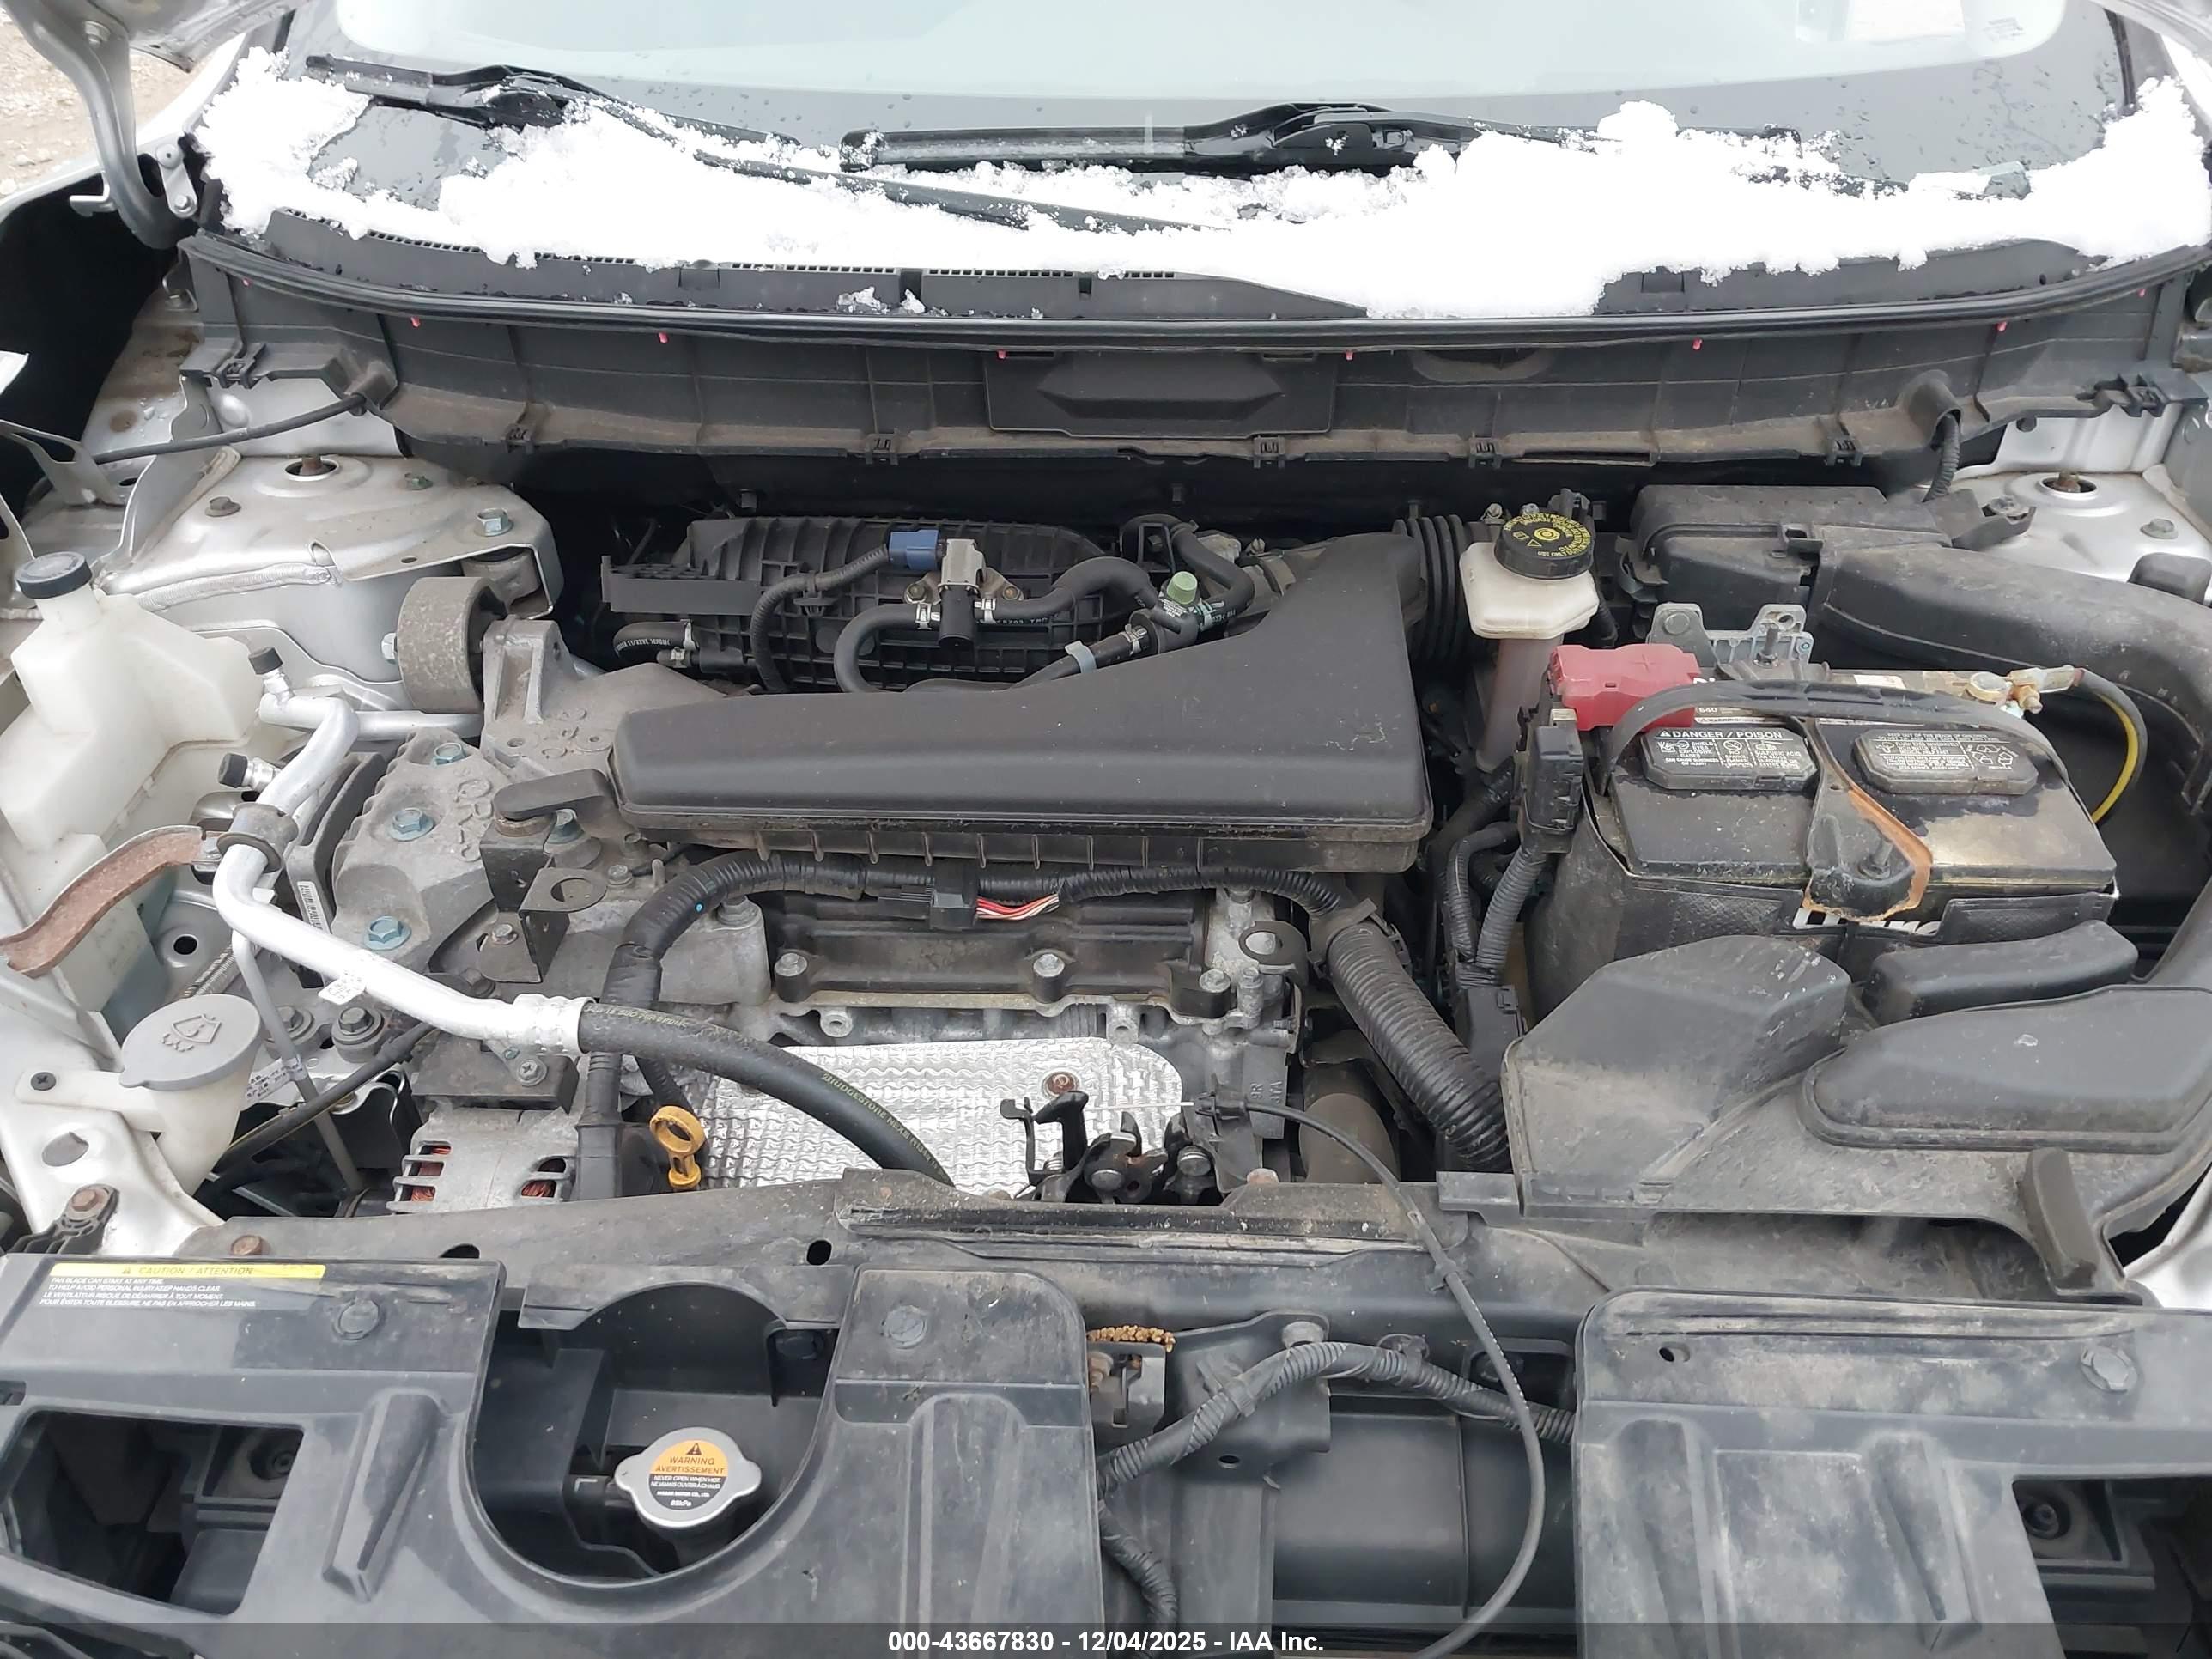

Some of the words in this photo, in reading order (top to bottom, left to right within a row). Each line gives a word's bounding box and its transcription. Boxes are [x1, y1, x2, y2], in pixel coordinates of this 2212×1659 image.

[197, 1267, 255, 1275] ATTENTION
[670, 1456, 714, 1465] WARNING
[655, 1465, 724, 1474] AVERTISSEMENT
